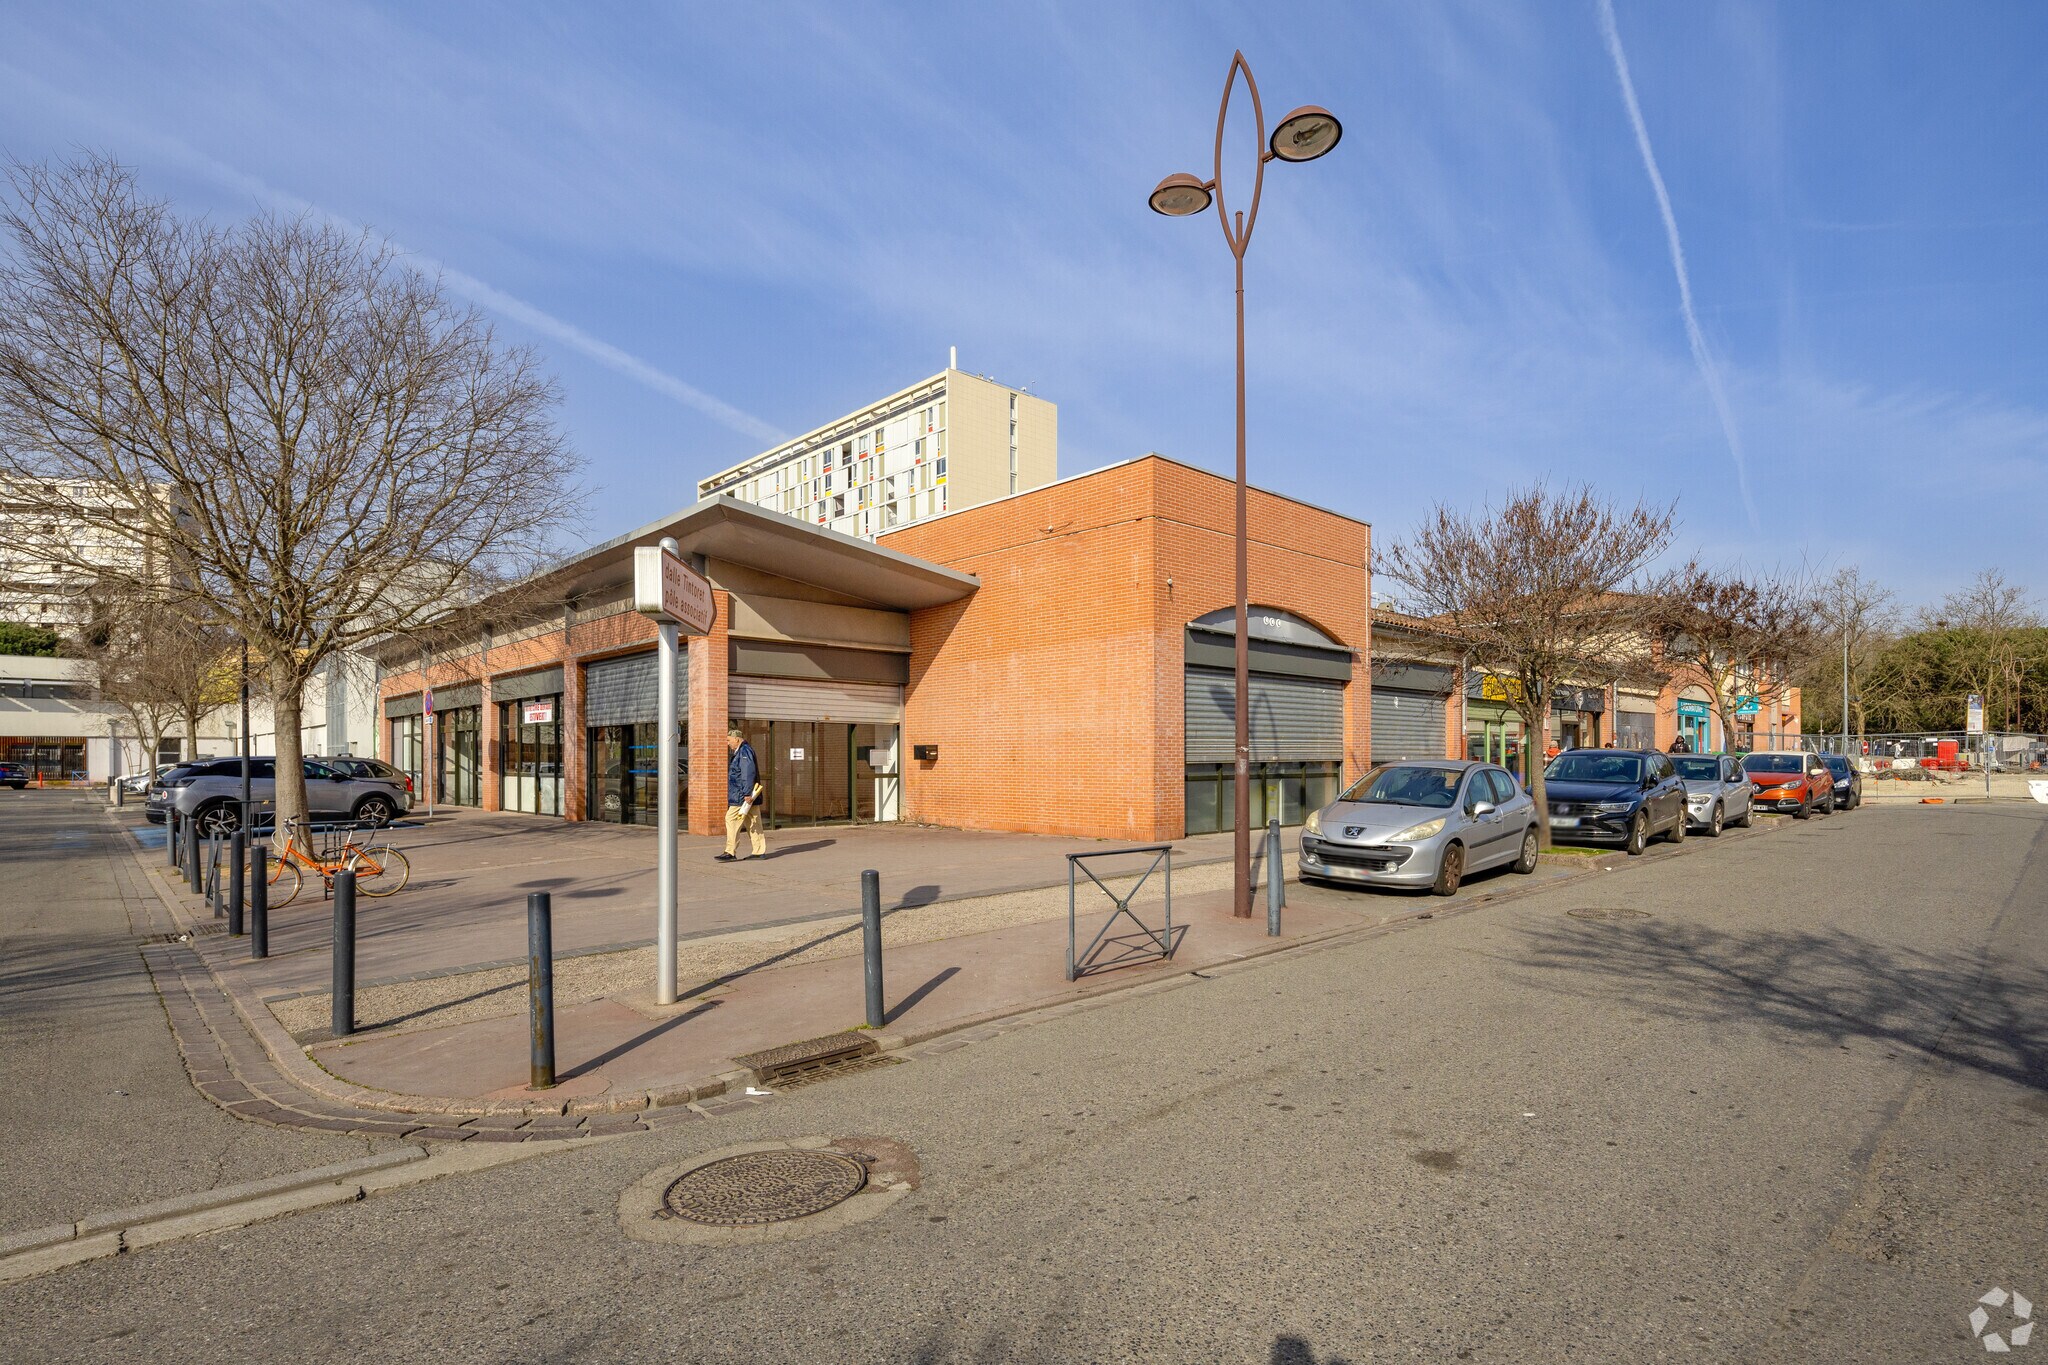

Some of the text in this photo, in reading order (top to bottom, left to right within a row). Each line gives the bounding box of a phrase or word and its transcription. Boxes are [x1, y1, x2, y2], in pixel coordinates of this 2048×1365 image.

[665, 562, 705, 603] dalle Tintoret
[665, 589, 708, 625] pôle associatif
